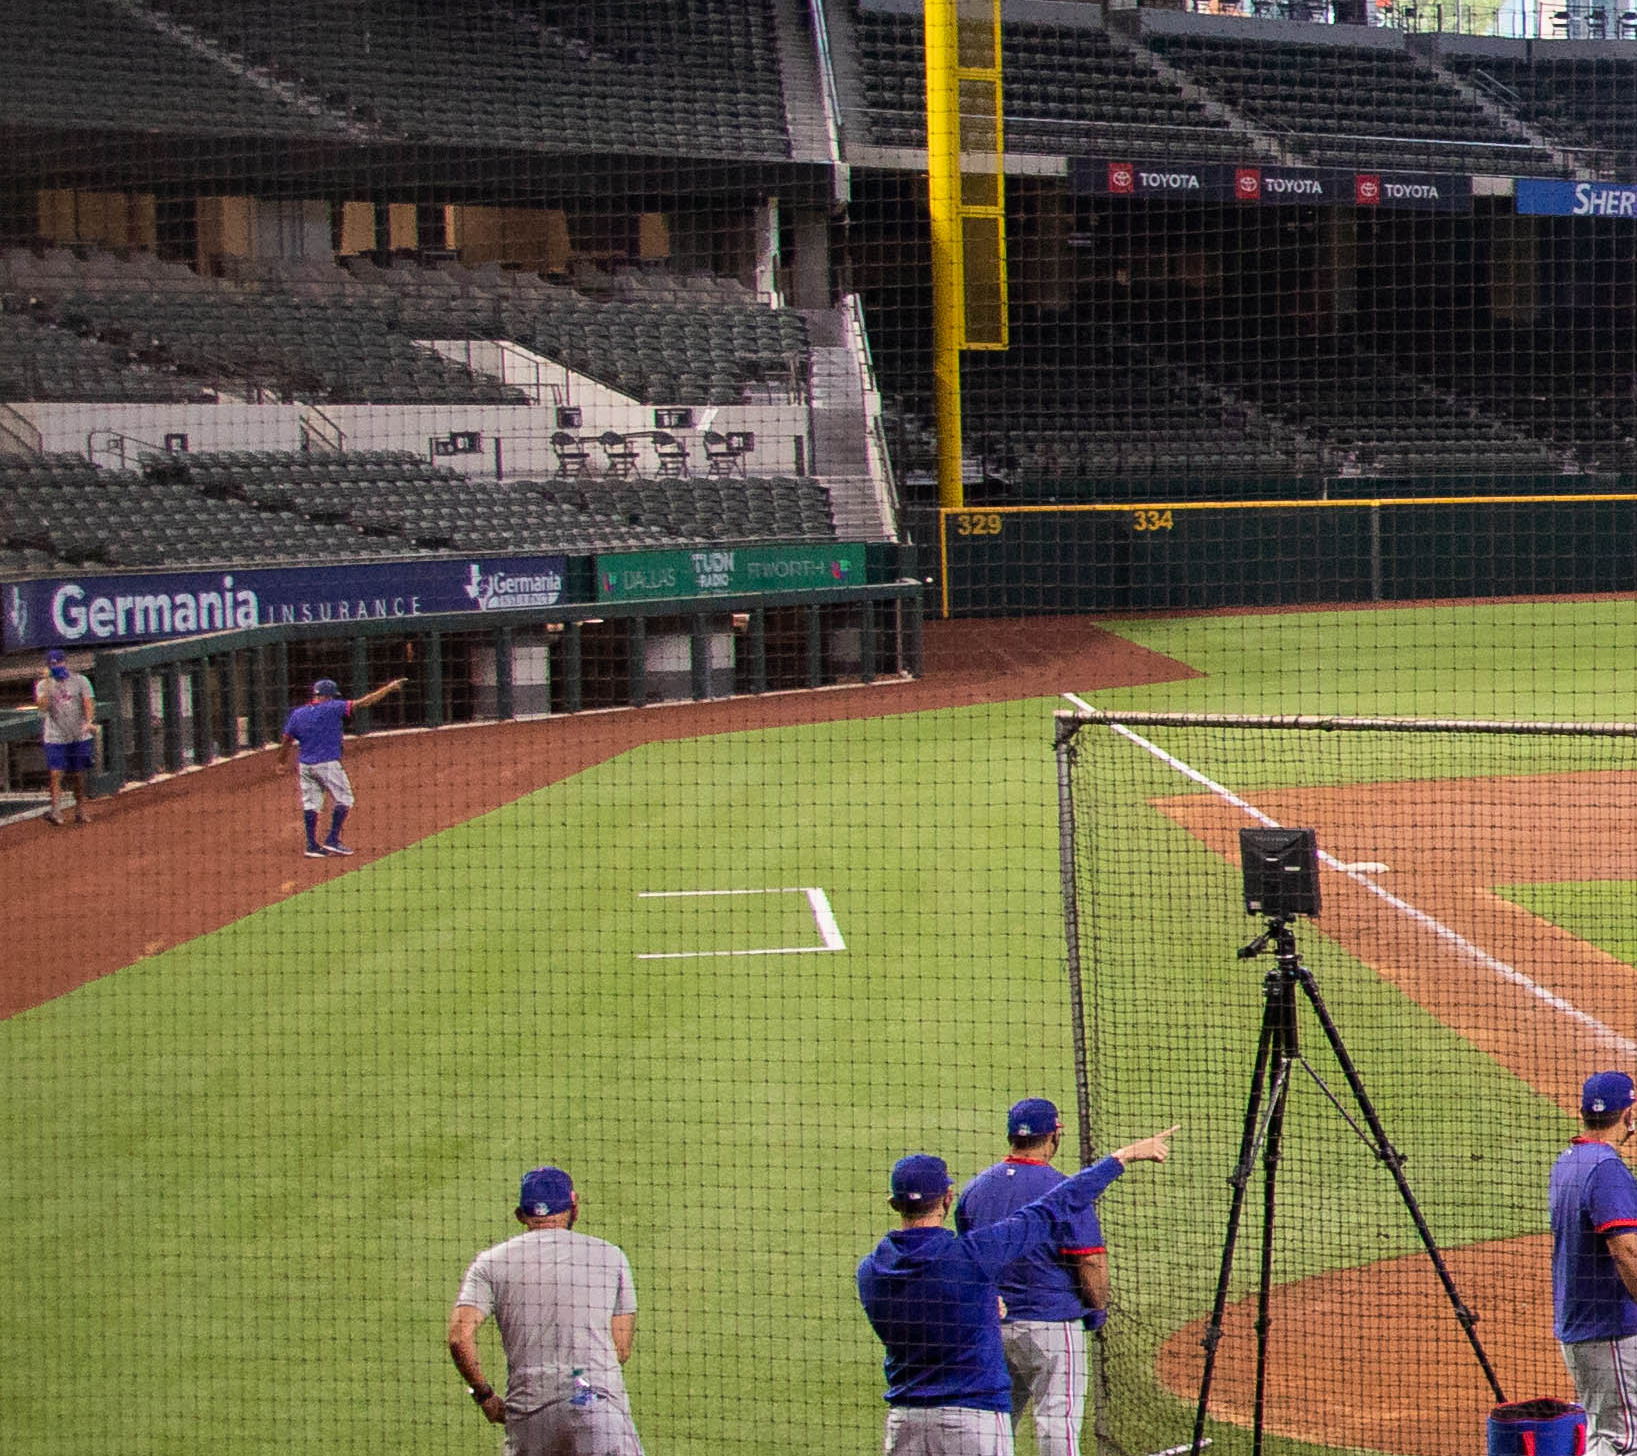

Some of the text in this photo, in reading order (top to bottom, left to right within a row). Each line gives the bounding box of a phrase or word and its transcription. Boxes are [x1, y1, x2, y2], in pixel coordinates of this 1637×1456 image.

[1139, 172, 1200, 190] TOYOTA
[1265, 178, 1322, 195] TOYOTA
[1384, 183, 1439, 199] TOYOTA
[957, 514, 1001, 535] 329
[1132, 511, 1174, 531] 334
[494, 570, 562, 594] Germania
[53, 575, 423, 639] Germania INSURANCE
